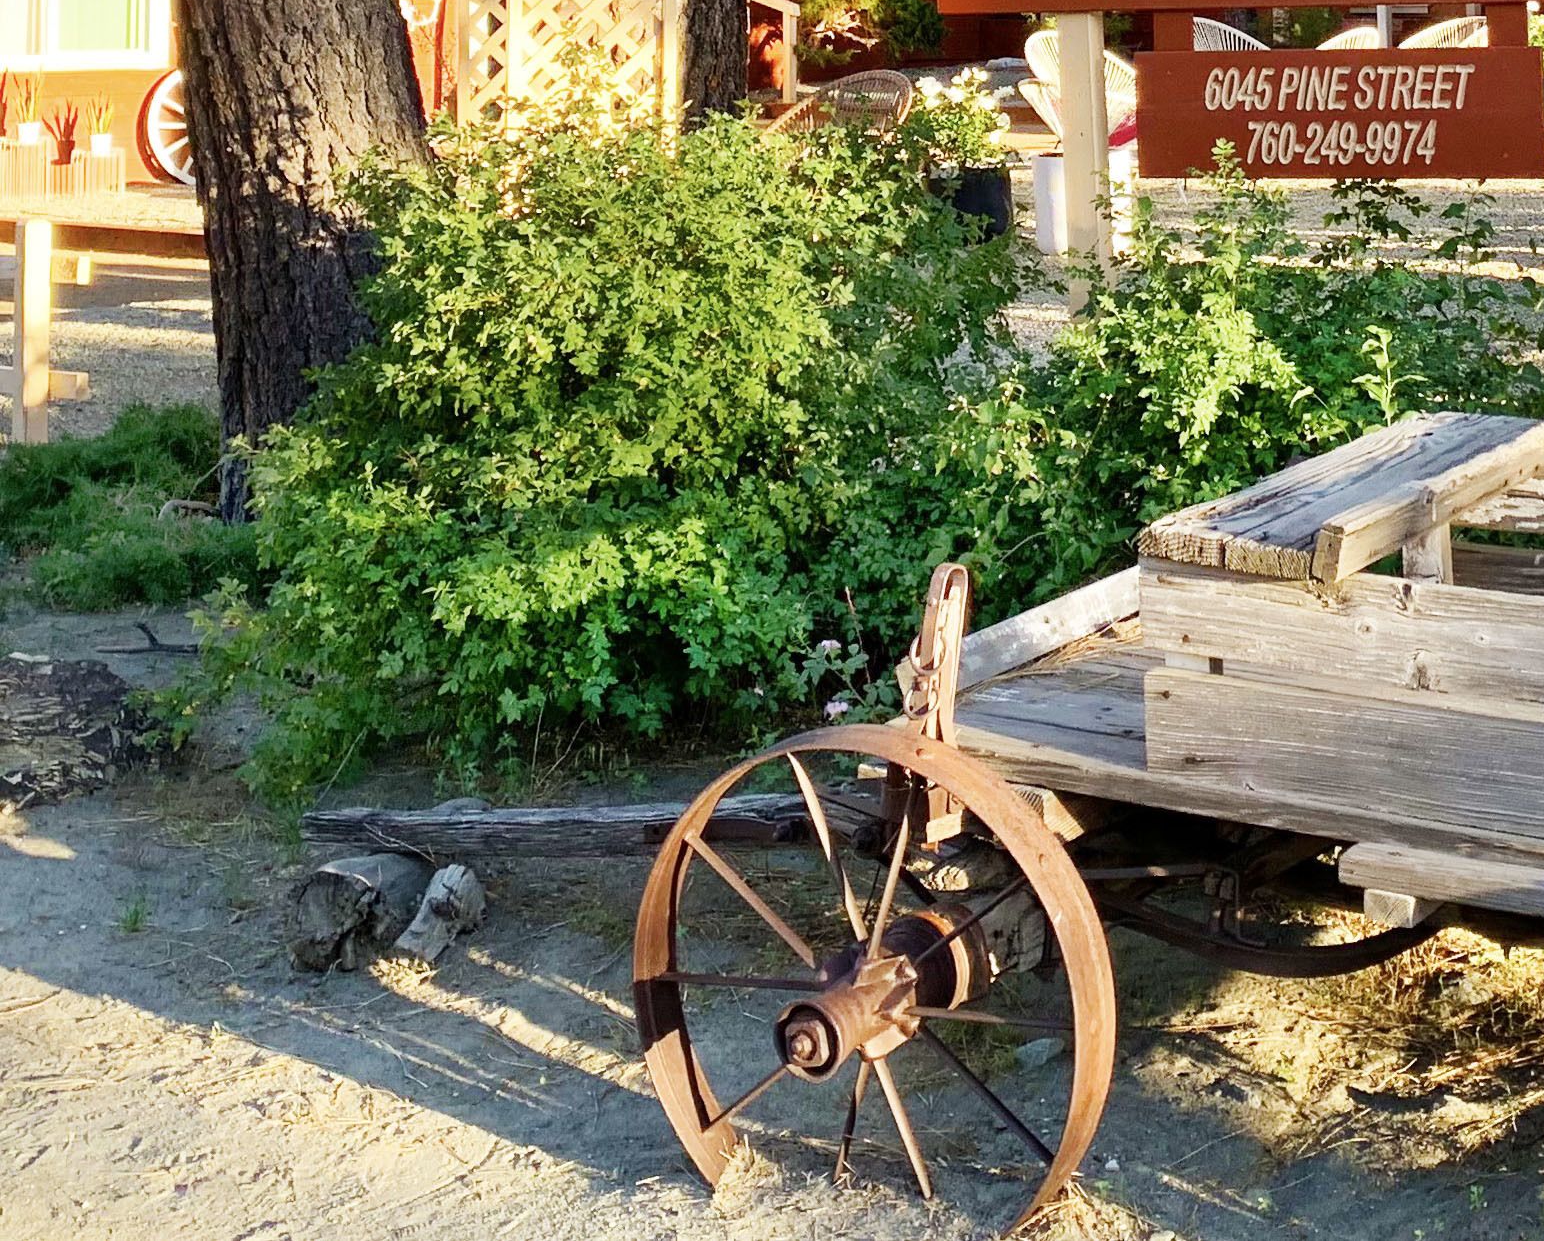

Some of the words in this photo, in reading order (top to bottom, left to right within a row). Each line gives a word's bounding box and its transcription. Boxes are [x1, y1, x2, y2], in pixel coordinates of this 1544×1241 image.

[1205, 67, 1274, 111] 6045
[1278, 65, 1350, 111] PINE
[1354, 63, 1475, 110] STREET
[1247, 119, 1437, 166] 760-249-9974
